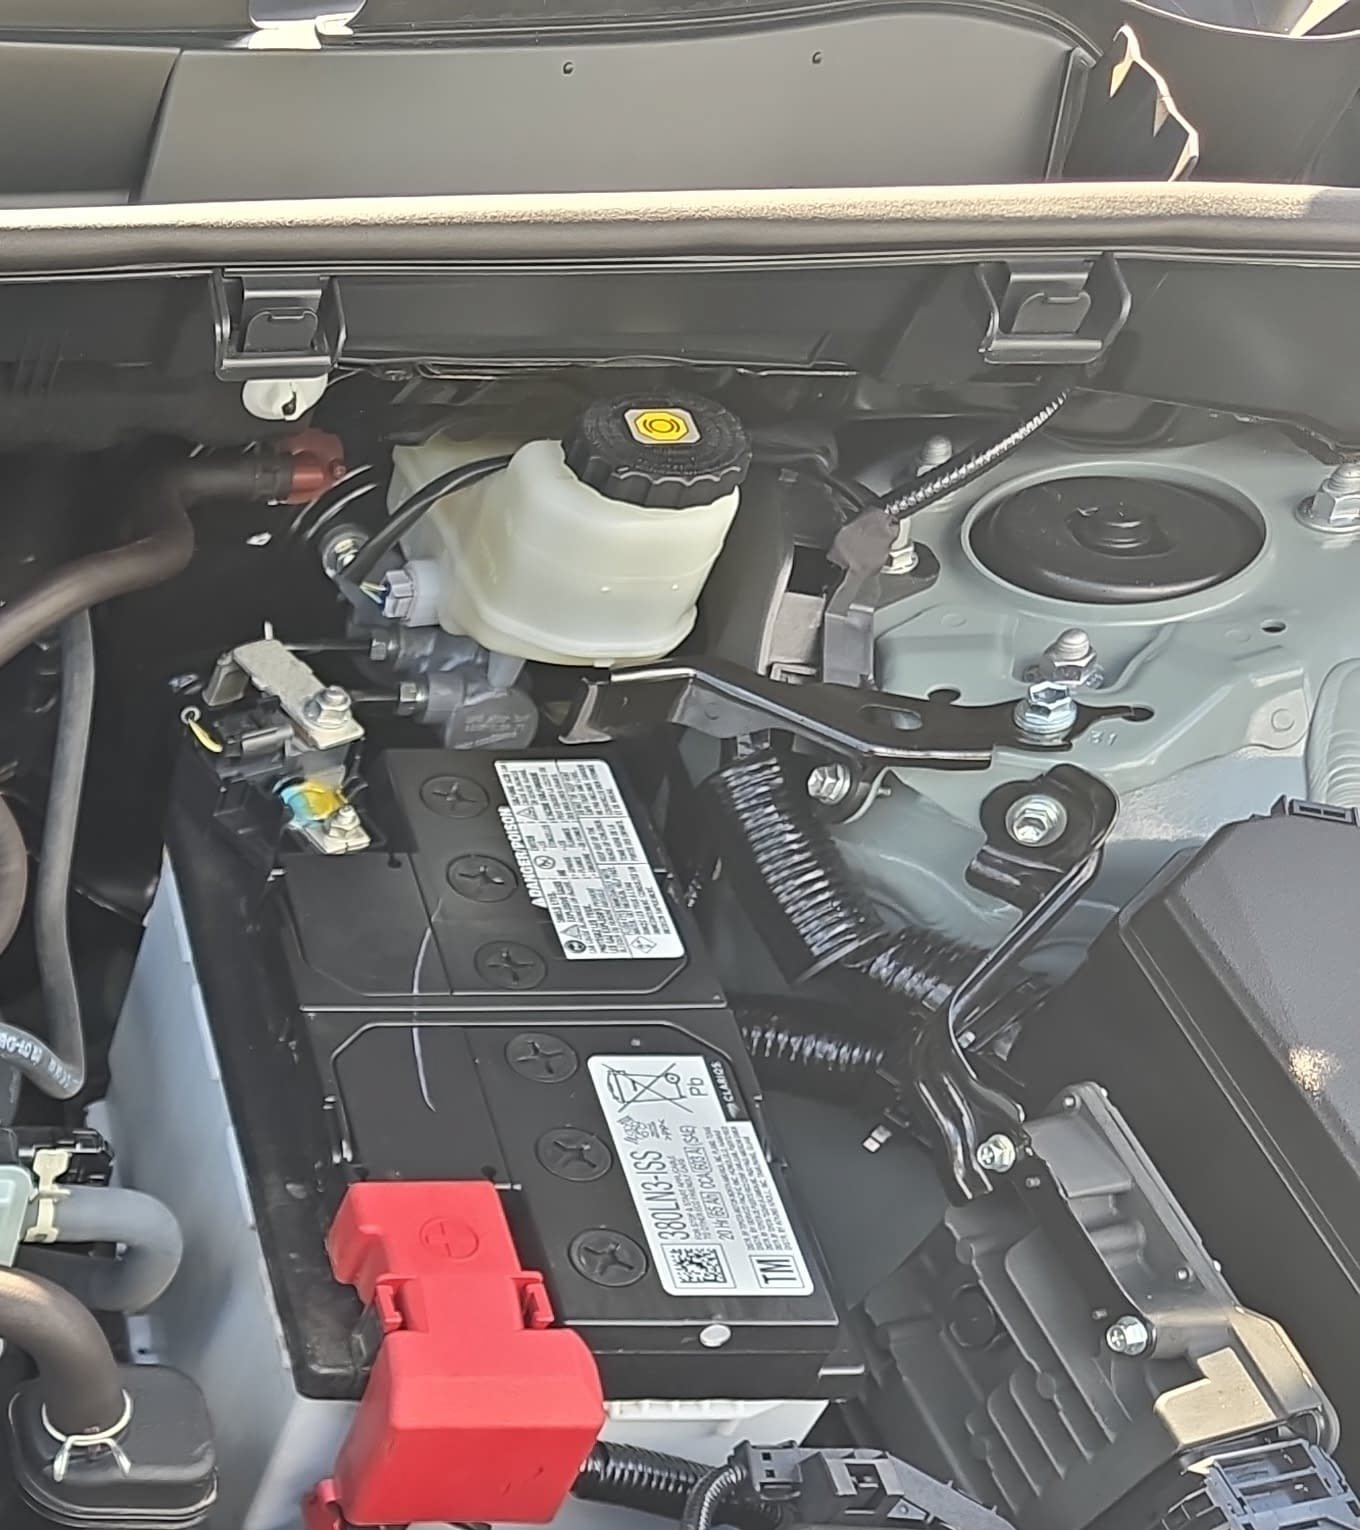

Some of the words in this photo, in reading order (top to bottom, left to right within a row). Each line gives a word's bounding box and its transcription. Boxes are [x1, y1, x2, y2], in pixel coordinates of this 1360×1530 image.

[498, 805, 542, 899] DANGER/POISON
[689, 1077, 709, 1097] Pb
[711, 1061, 734, 1104] CLARIOS
[630, 1150, 690, 1241] 380LN3-ISS
[756, 1259, 796, 1284] TM
